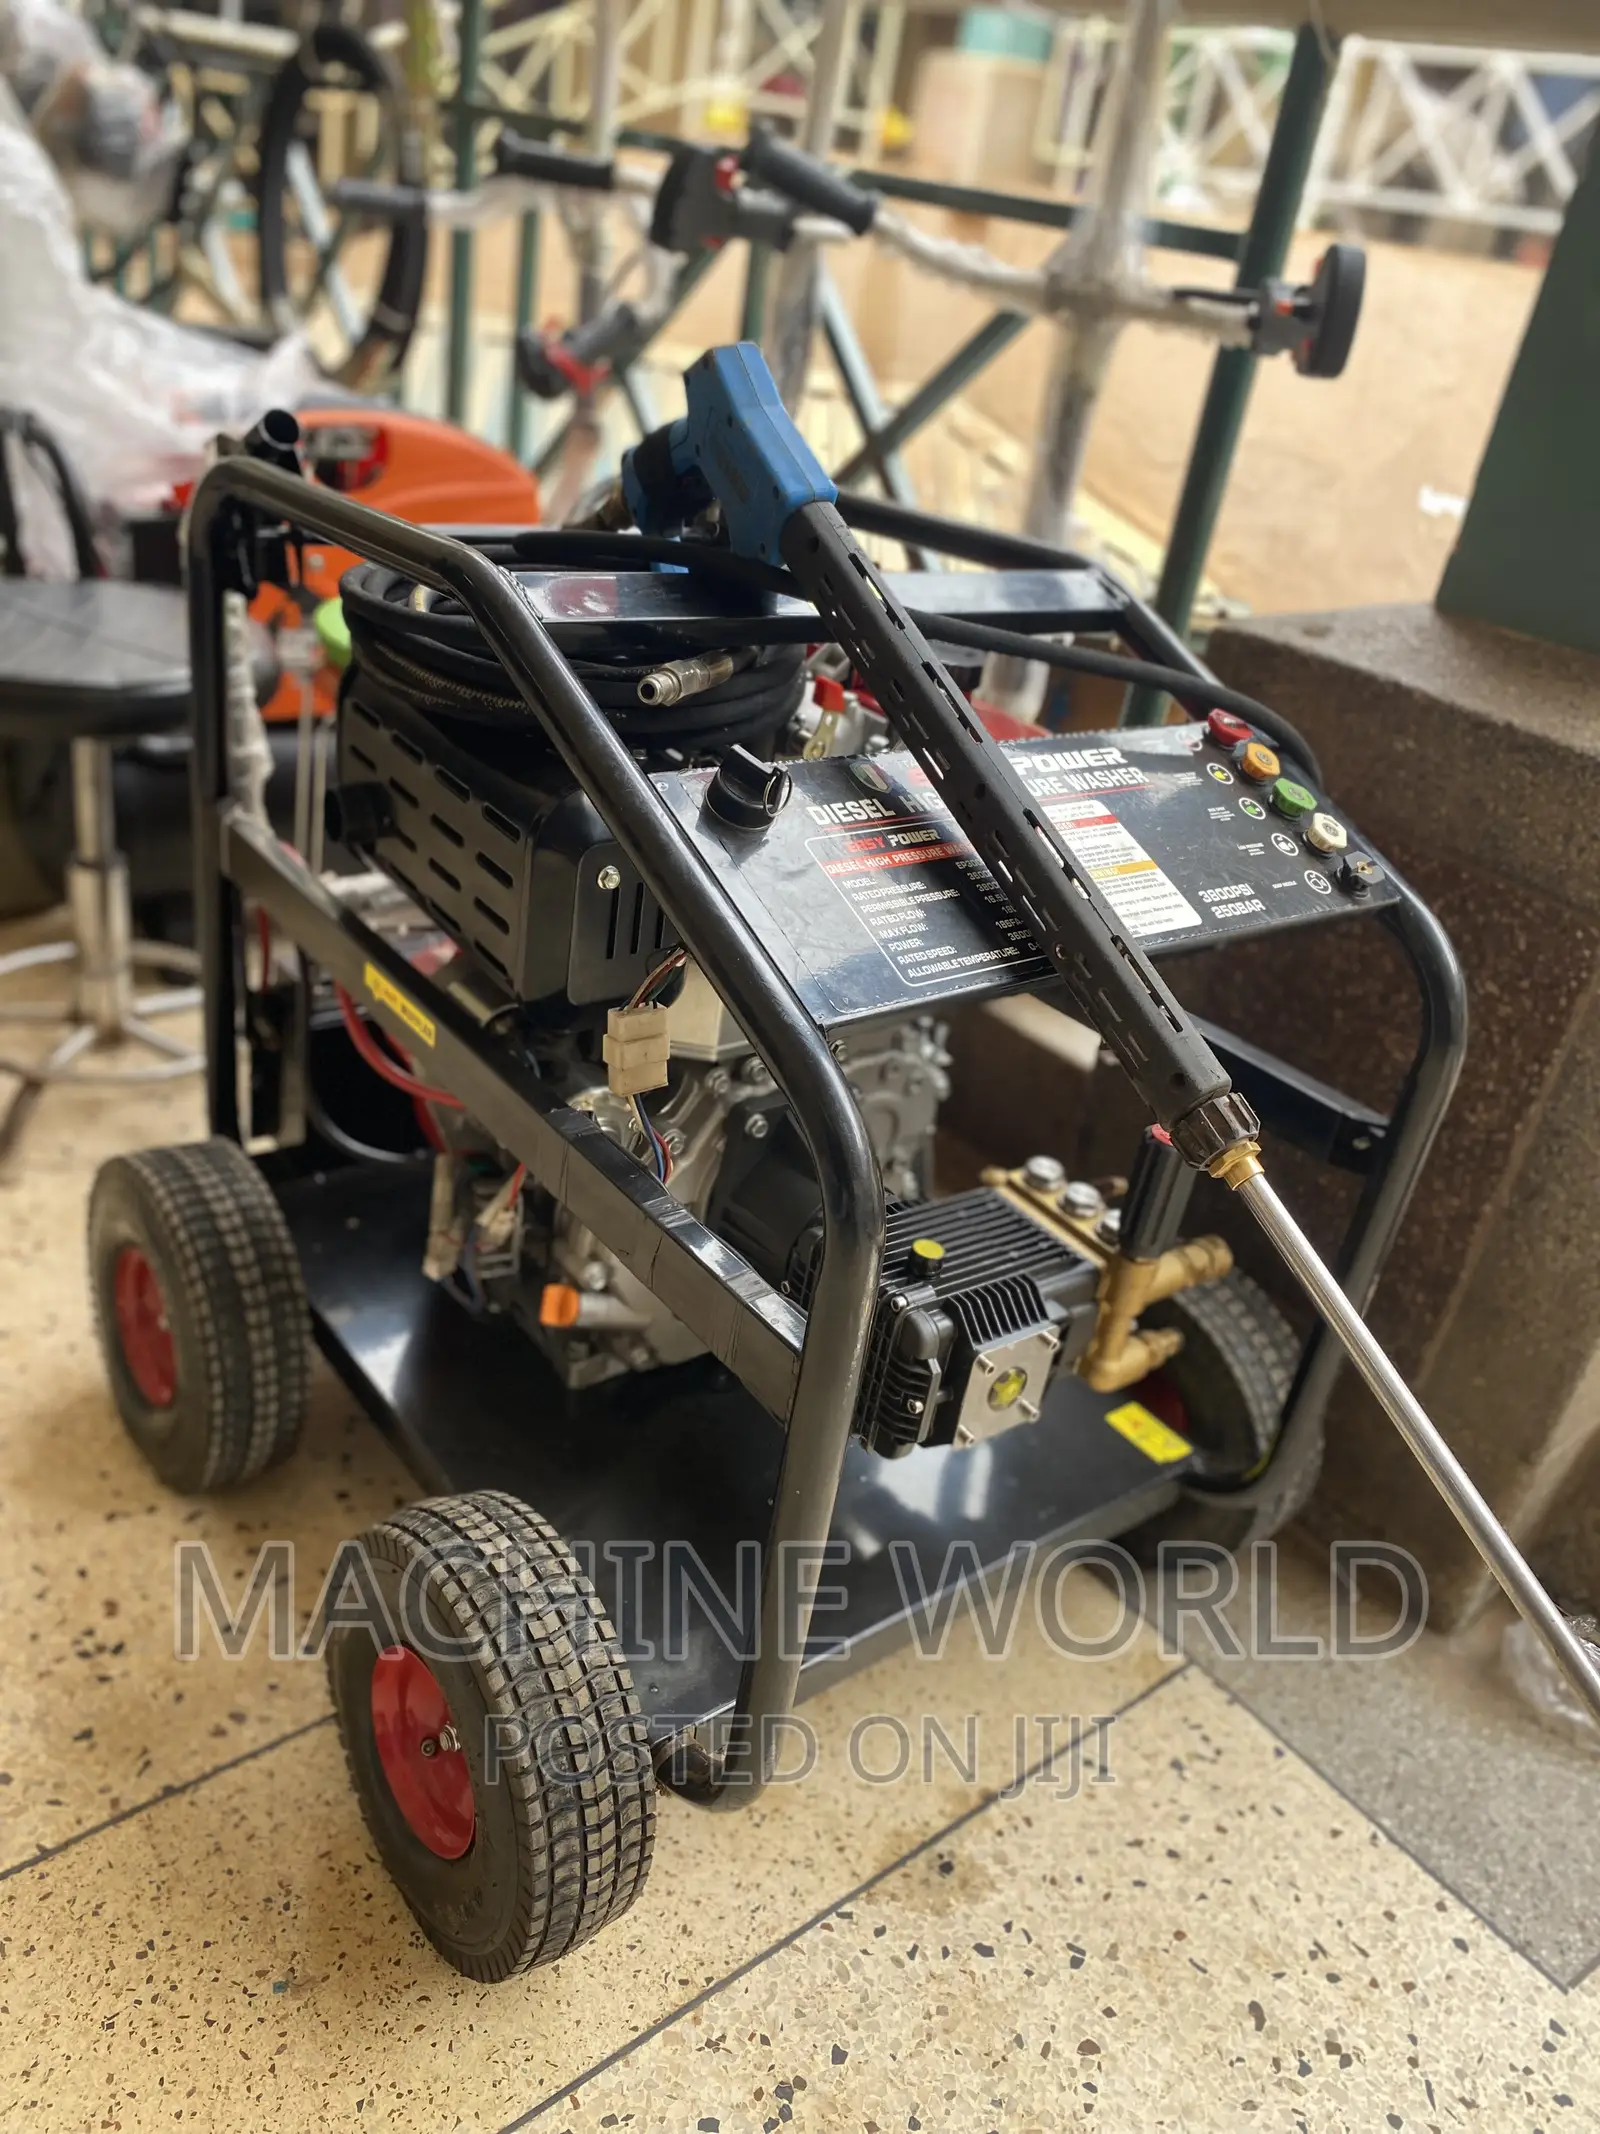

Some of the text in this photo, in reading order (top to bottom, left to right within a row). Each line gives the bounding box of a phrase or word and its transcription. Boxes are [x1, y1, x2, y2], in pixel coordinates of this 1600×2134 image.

[1009, 746, 1129, 776] POWER
[806, 798, 896, 826] DIESEL
[898, 791, 947, 813] HIG
[1022, 775, 1068, 798] URE
[1063, 766, 1150, 793] WASHER
[846, 827, 941, 854] EASY POWER
[825, 860, 866, 874] DIESEL
[863, 855, 892, 869] HIGH
[892, 847, 945, 864] PRESSURE
[842, 859, 982, 889] MODEL: EP300
[851, 889, 883, 902] RATED
[880, 880, 927, 899] PRESSURE:
[860, 881, 1000, 914] PERMISSIBLE PRESSURE: 3800
[1198, 883, 1255, 903] 3800PSI
[869, 892, 1009, 928] RATED FLOW: 16.5L
[1210, 898, 1267, 919] 250BAR
[878, 926, 903, 939] MAX
[901, 922, 930, 936] FLOW:
[888, 937, 925, 953] POWER:
[897, 952, 930, 966] RATED
[927, 945, 958, 961] SPEED:
[907, 961, 961, 979] ALLOWABLE
[957, 946, 1021, 970] TEMPERATURE:
